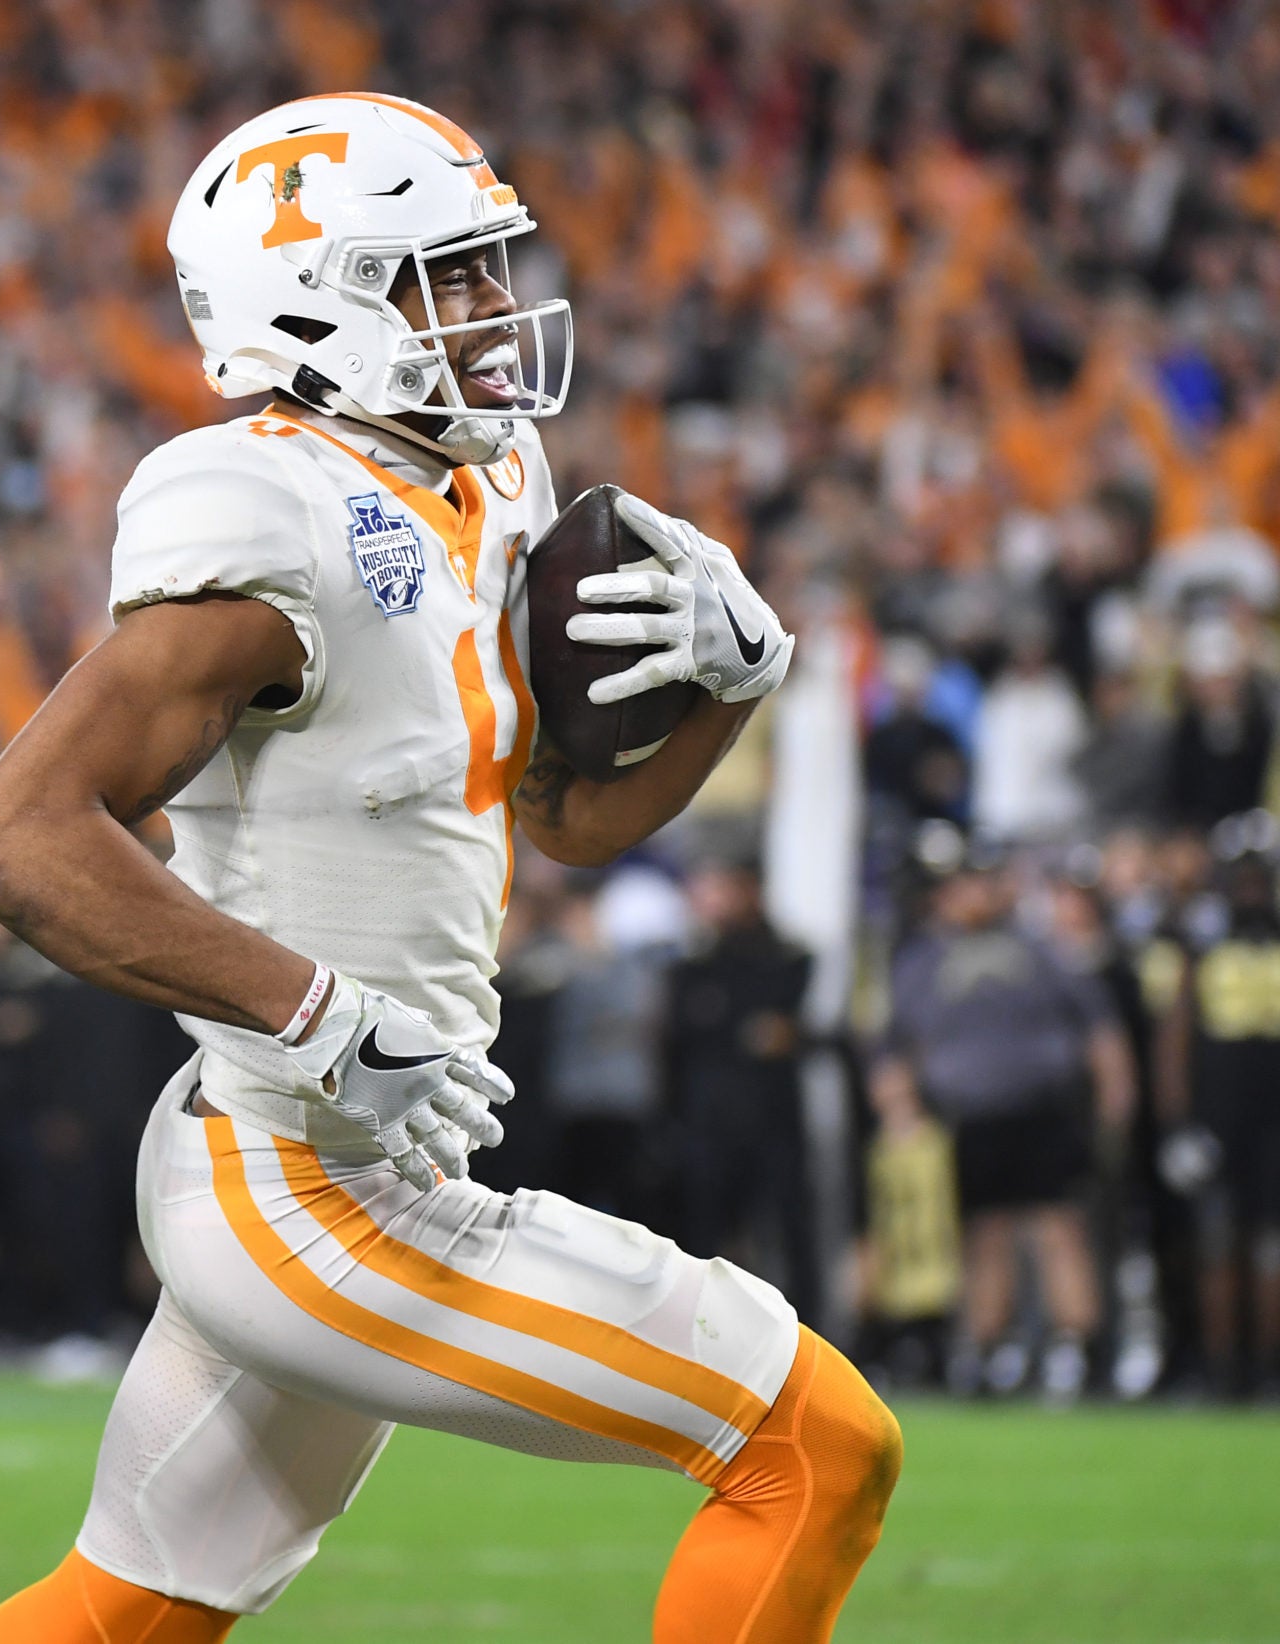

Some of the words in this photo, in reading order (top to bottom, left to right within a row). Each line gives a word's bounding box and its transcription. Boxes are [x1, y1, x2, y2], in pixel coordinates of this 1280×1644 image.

[236, 132, 349, 250] T
[486, 453, 521, 498] SEC
[355, 531, 411, 550] TRANSPERFECT
[358, 549, 393, 576] MUSIC
[391, 543, 418, 565] CITY
[377, 565, 412, 587] BOWL
